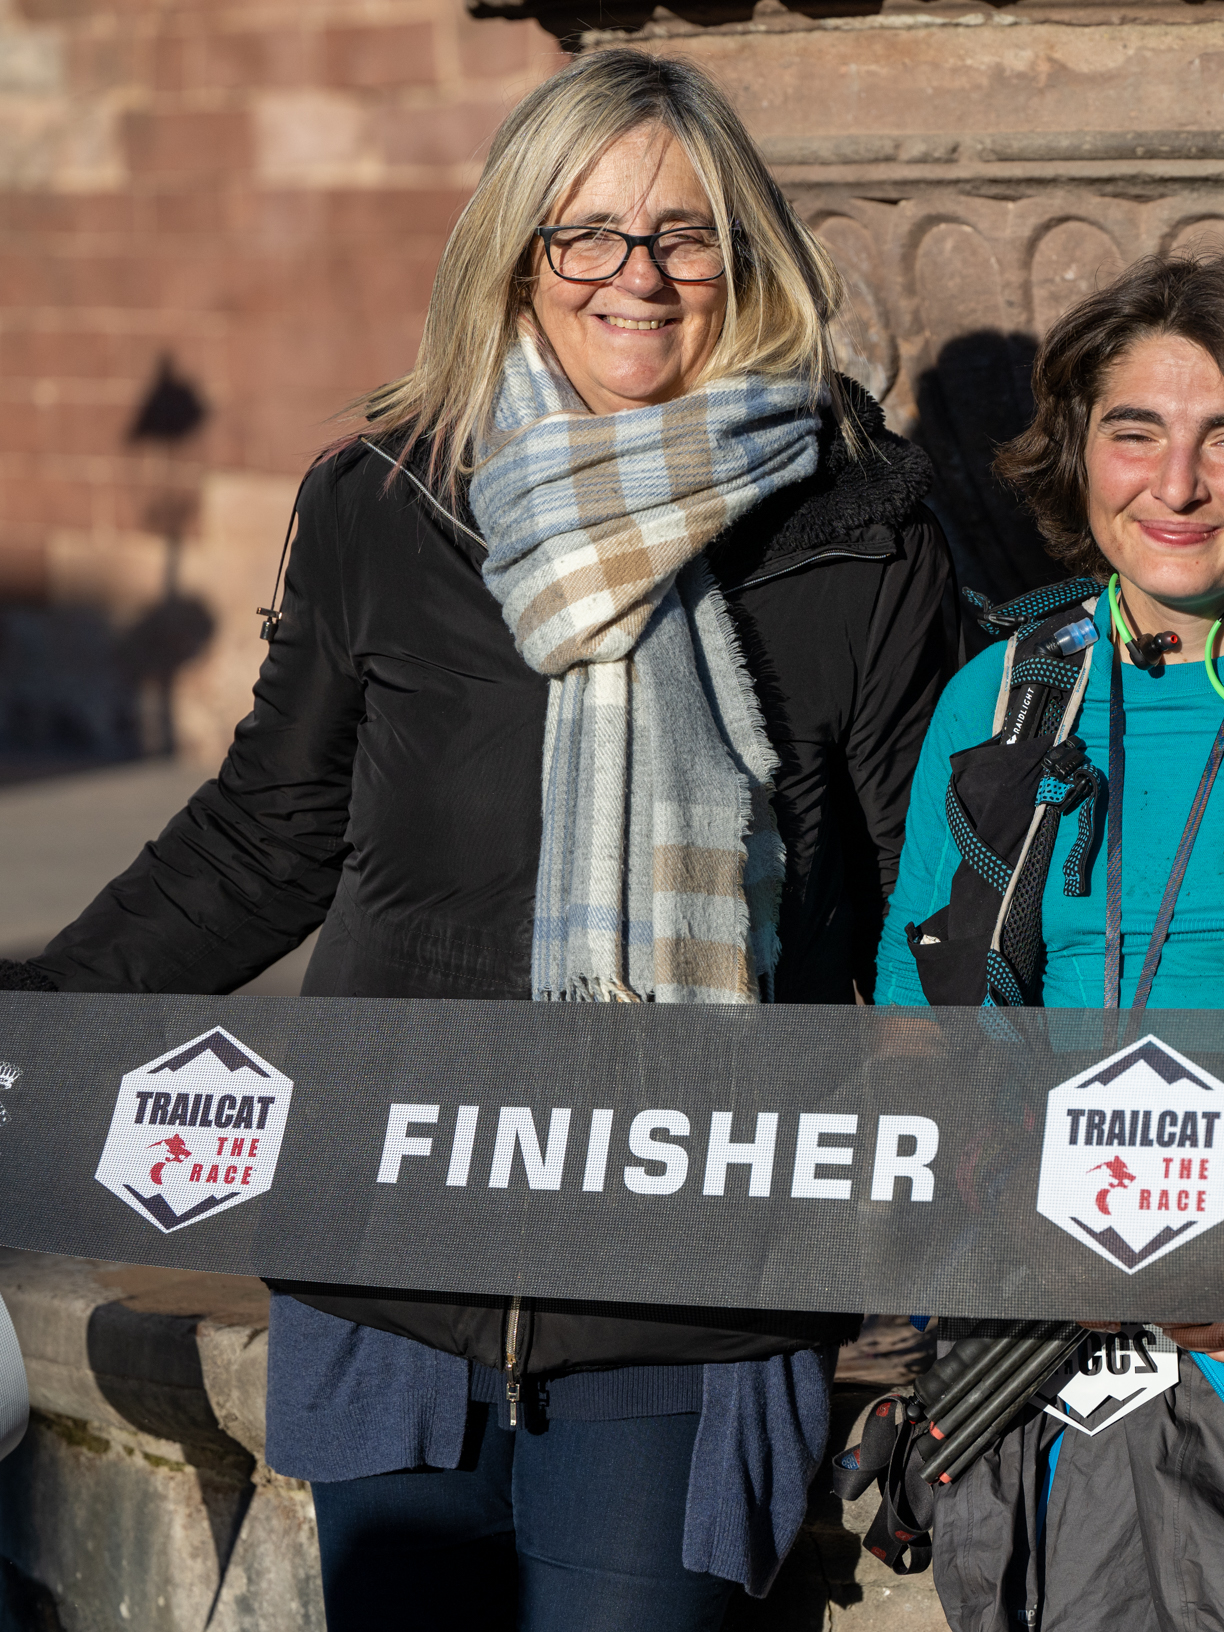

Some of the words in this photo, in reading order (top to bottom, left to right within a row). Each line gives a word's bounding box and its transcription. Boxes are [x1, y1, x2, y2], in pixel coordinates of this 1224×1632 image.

[1013, 687, 1035, 734] RAIDLIGHT
[134, 1091, 276, 1130] TRAILCAT
[1066, 1108, 1222, 1149] TRAILCAT
[216, 1137, 260, 1157] THE
[375, 1103, 940, 1202] FINISHER
[189, 1163, 253, 1185] RACE
[1162, 1157, 1209, 1180] THE
[1138, 1189, 1207, 1212] RACE
